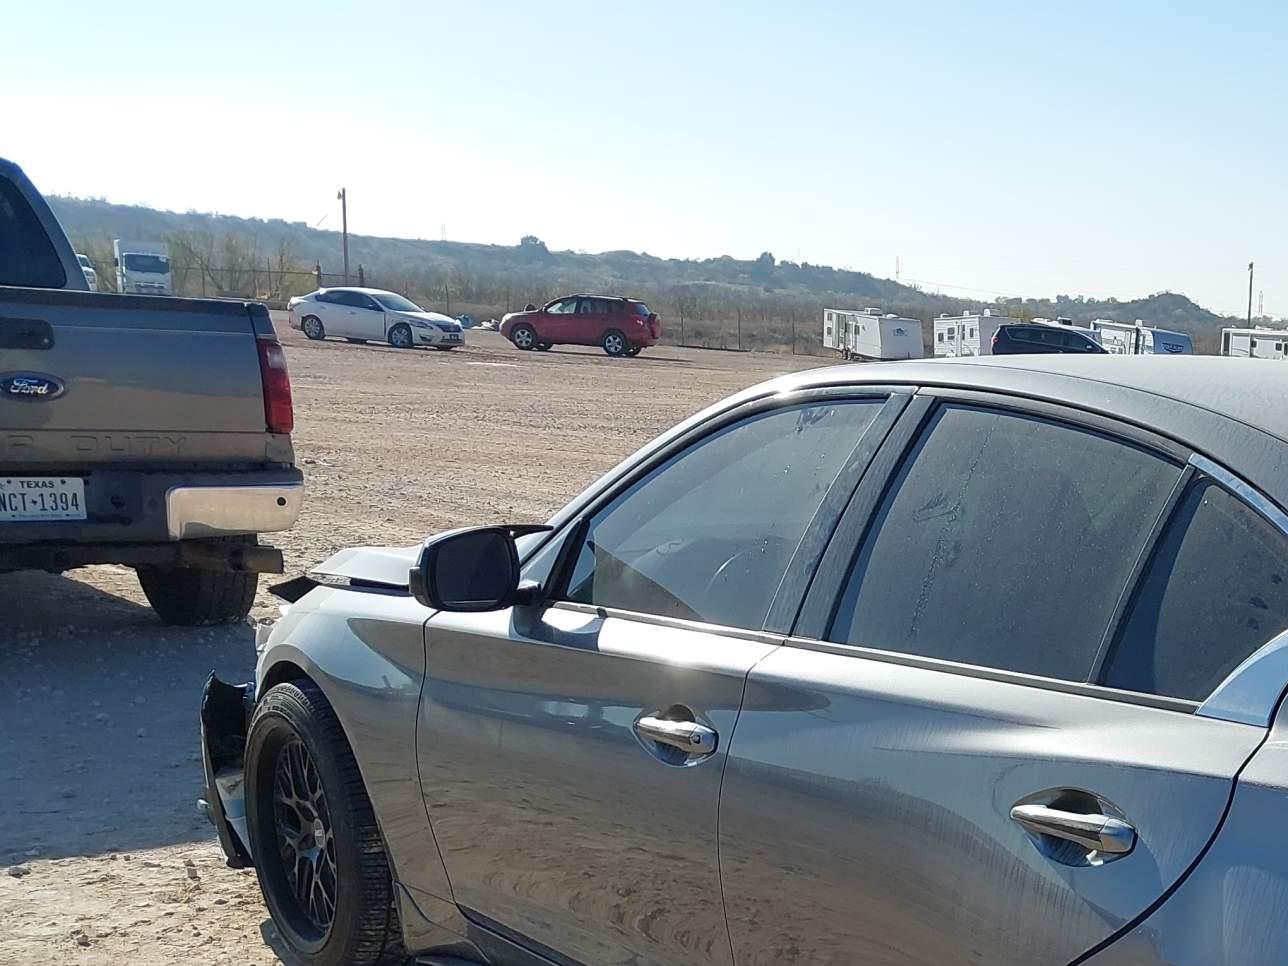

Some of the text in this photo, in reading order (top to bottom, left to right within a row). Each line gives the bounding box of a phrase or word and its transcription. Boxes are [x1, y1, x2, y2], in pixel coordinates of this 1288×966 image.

[10, 378, 49, 394] Ford
[71, 435, 187, 455] DUTY
[19, 480, 55, 489] TEXAS
